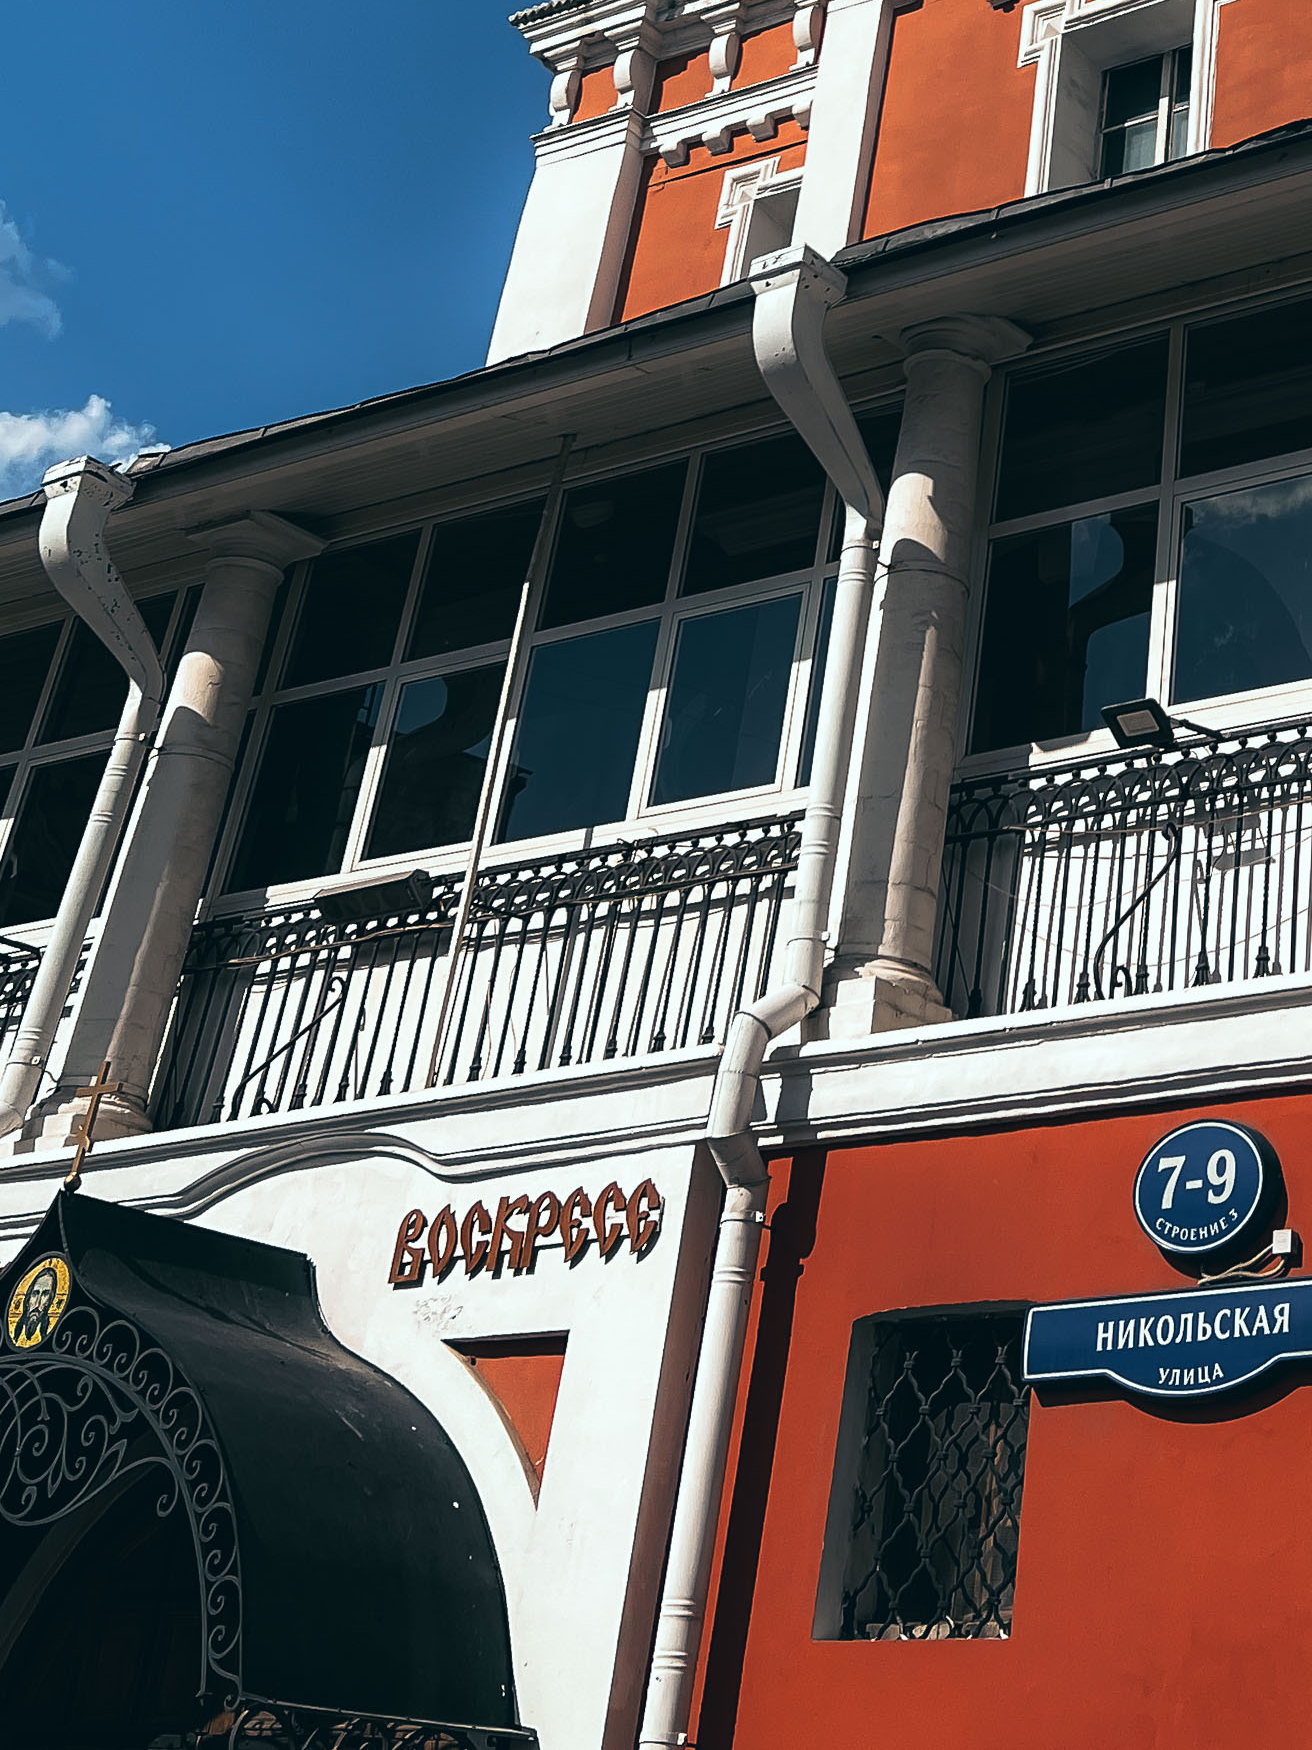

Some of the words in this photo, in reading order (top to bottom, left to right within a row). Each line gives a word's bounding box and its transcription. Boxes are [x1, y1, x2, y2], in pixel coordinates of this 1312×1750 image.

[1158, 1149, 1236, 1210] 7-9
[1155, 1217, 1229, 1241] СТРОЕНИЕ
[1229, 1208, 1239, 1222] 3
[1096, 1302, 1290, 1352] НИКОЛЬСКАЯ
[1158, 1362, 1225, 1386] УЛИЦА
